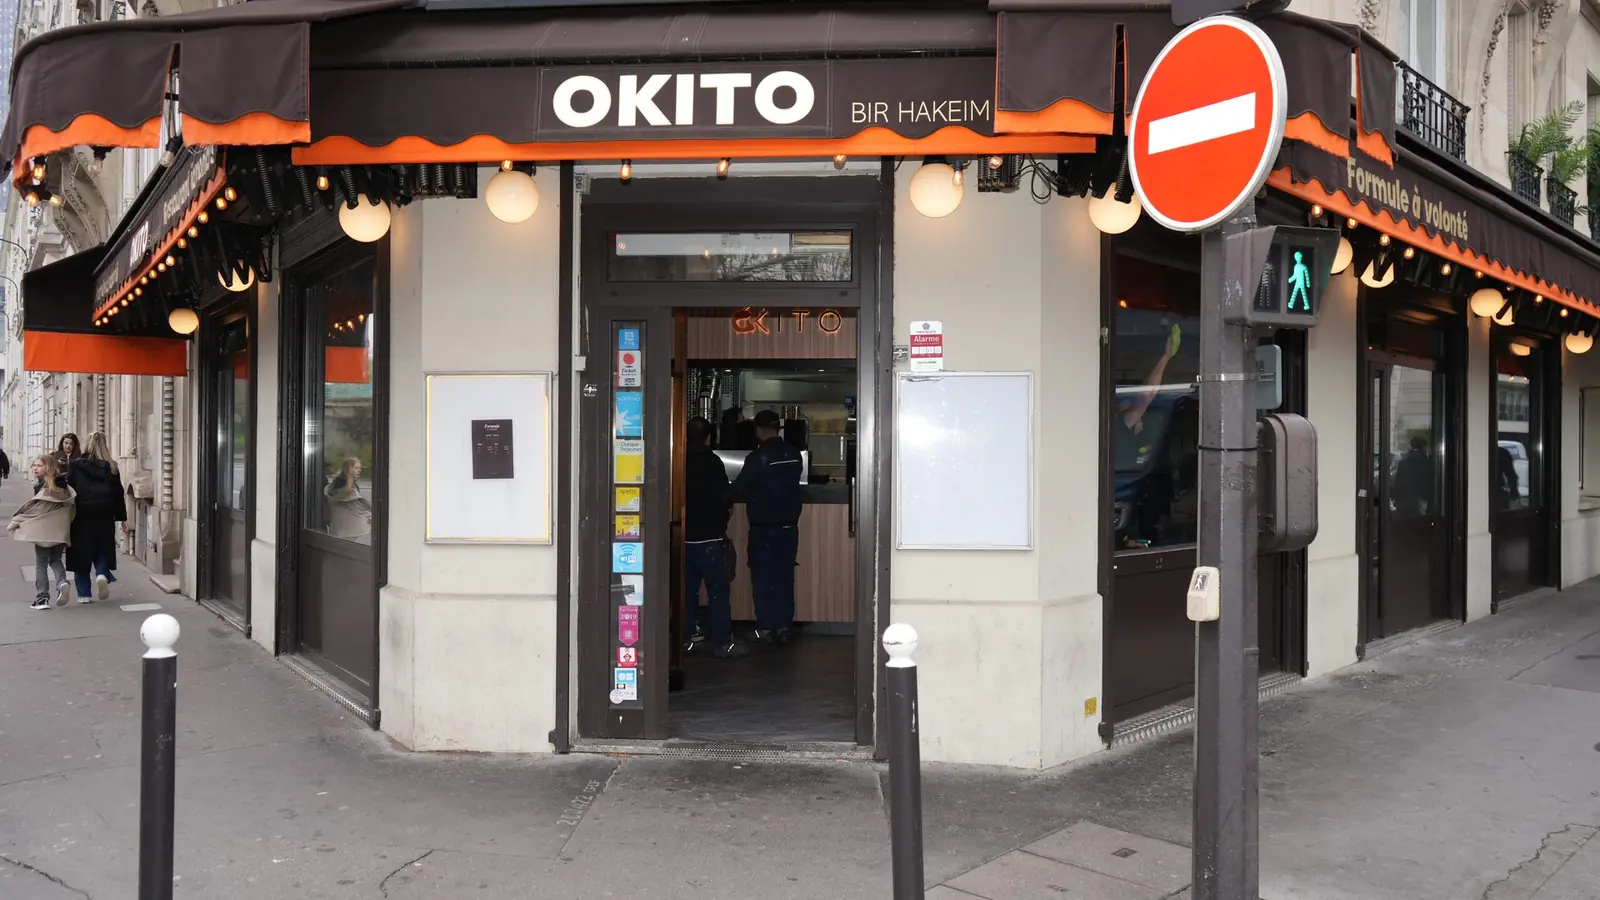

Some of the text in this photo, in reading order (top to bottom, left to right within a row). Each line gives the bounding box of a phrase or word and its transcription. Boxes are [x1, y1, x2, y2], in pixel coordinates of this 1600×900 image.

[552, 70, 815, 128] OKITO
[851, 99, 991, 123] BIR HAKEIM
[1346, 157, 1469, 241] Formule à volonté
[914, 335, 940, 343] Alarme
